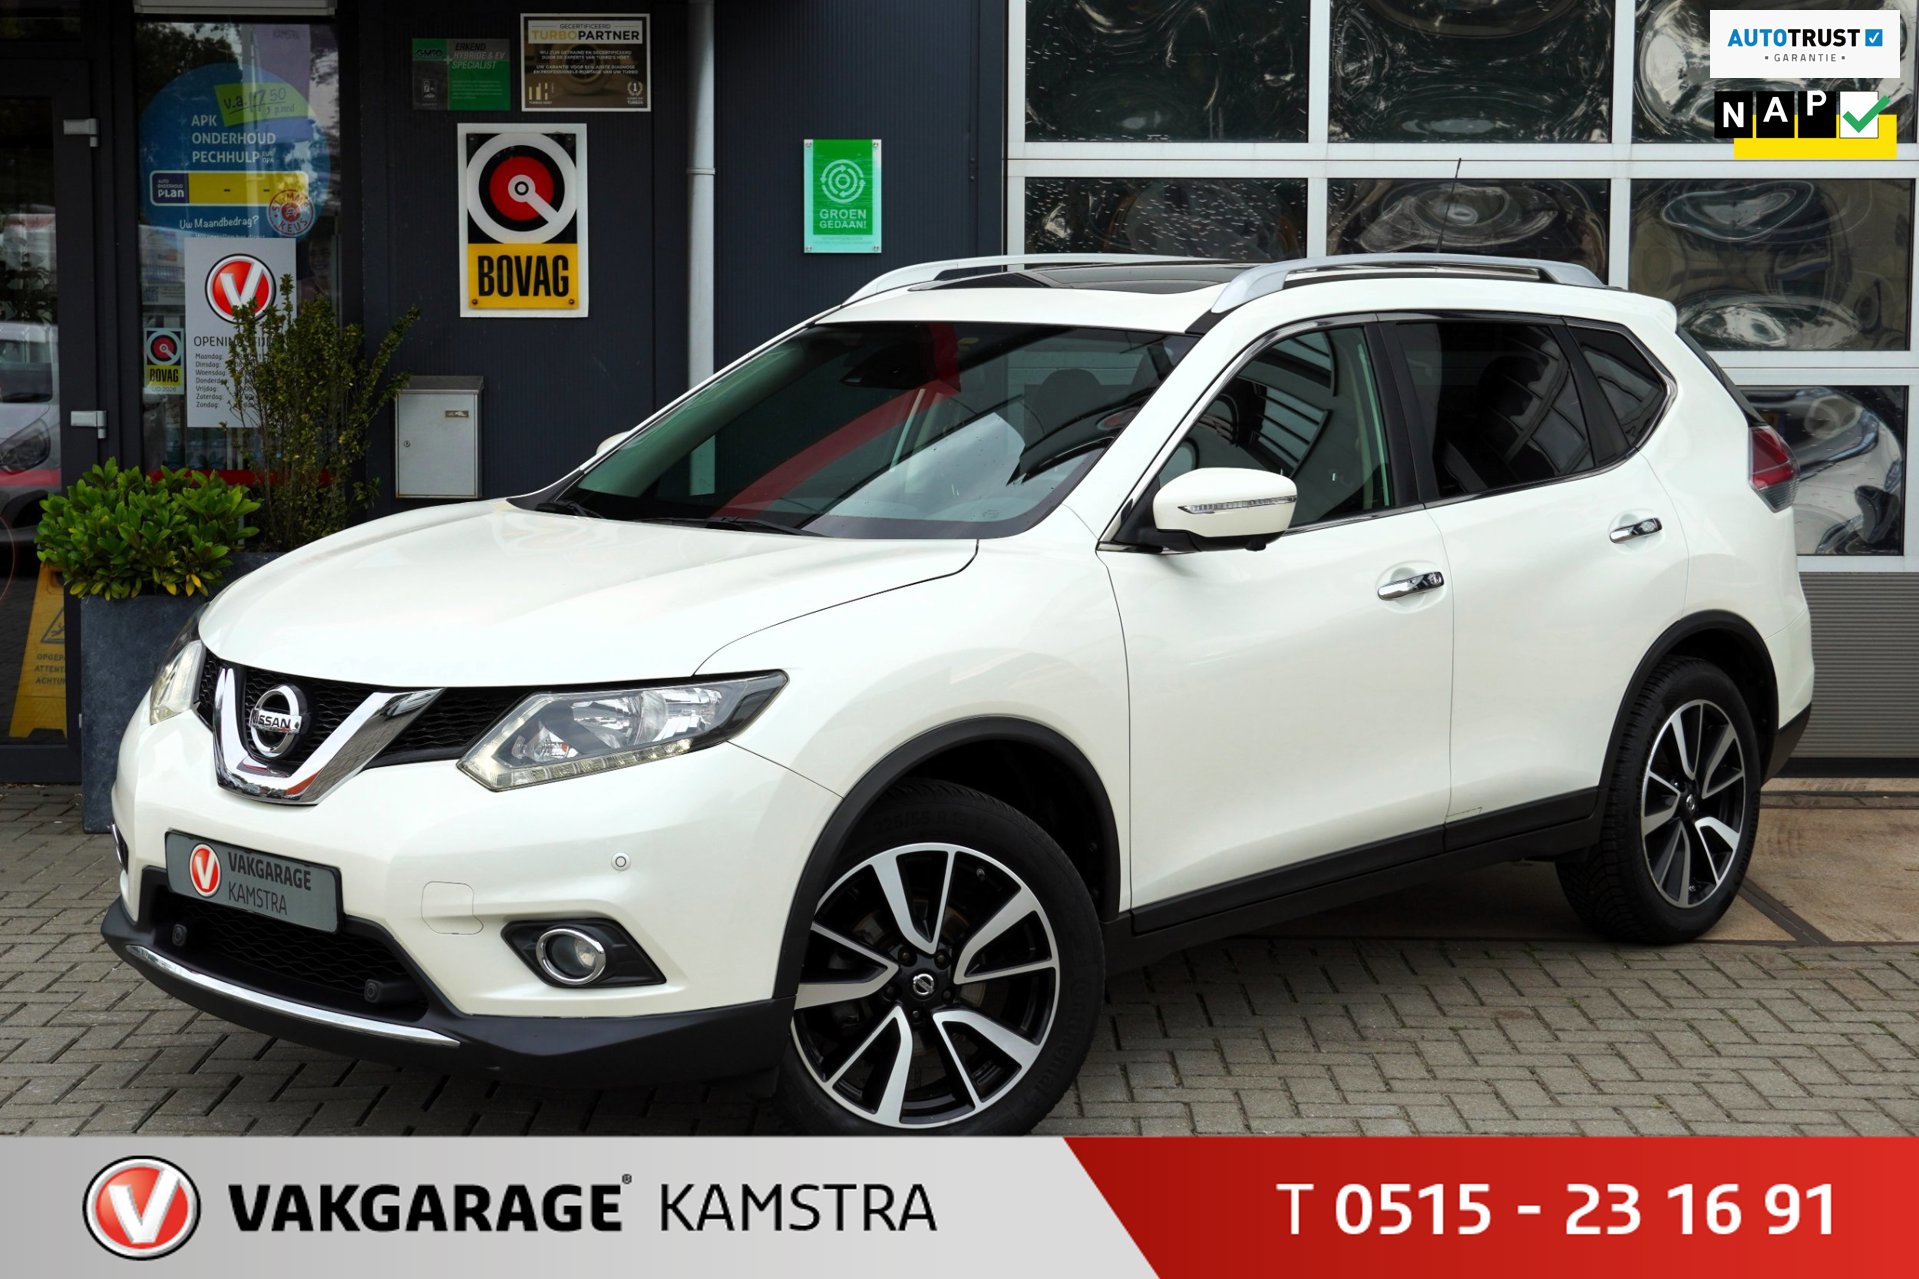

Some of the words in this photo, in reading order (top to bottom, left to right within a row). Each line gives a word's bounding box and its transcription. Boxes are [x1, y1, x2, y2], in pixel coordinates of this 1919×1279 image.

[531, 30, 640, 41] TURBOPARTNER
[455, 42, 486, 51] ERKEND
[453, 51, 486, 60] HYBRIDE
[494, 51, 505, 60] EV
[451, 60, 496, 70] SPECIALIST
[191, 115, 217, 127] APK
[191, 132, 276, 145] ONDERHOUD
[192, 151, 260, 163] PECHHULP
[819, 209, 867, 219] GROEN
[179, 219, 193, 229] Uw
[194, 215, 259, 229] Maandbedrag?
[819, 220, 867, 229] GEDAAN!
[477, 254, 570, 297] BOVAG
[149, 369, 179, 383] BOVAG
[252, 712, 292, 729] NISSAN
[228, 851, 312, 891] VAKGARAGE
[228, 880, 288, 916] KAMSTRA
